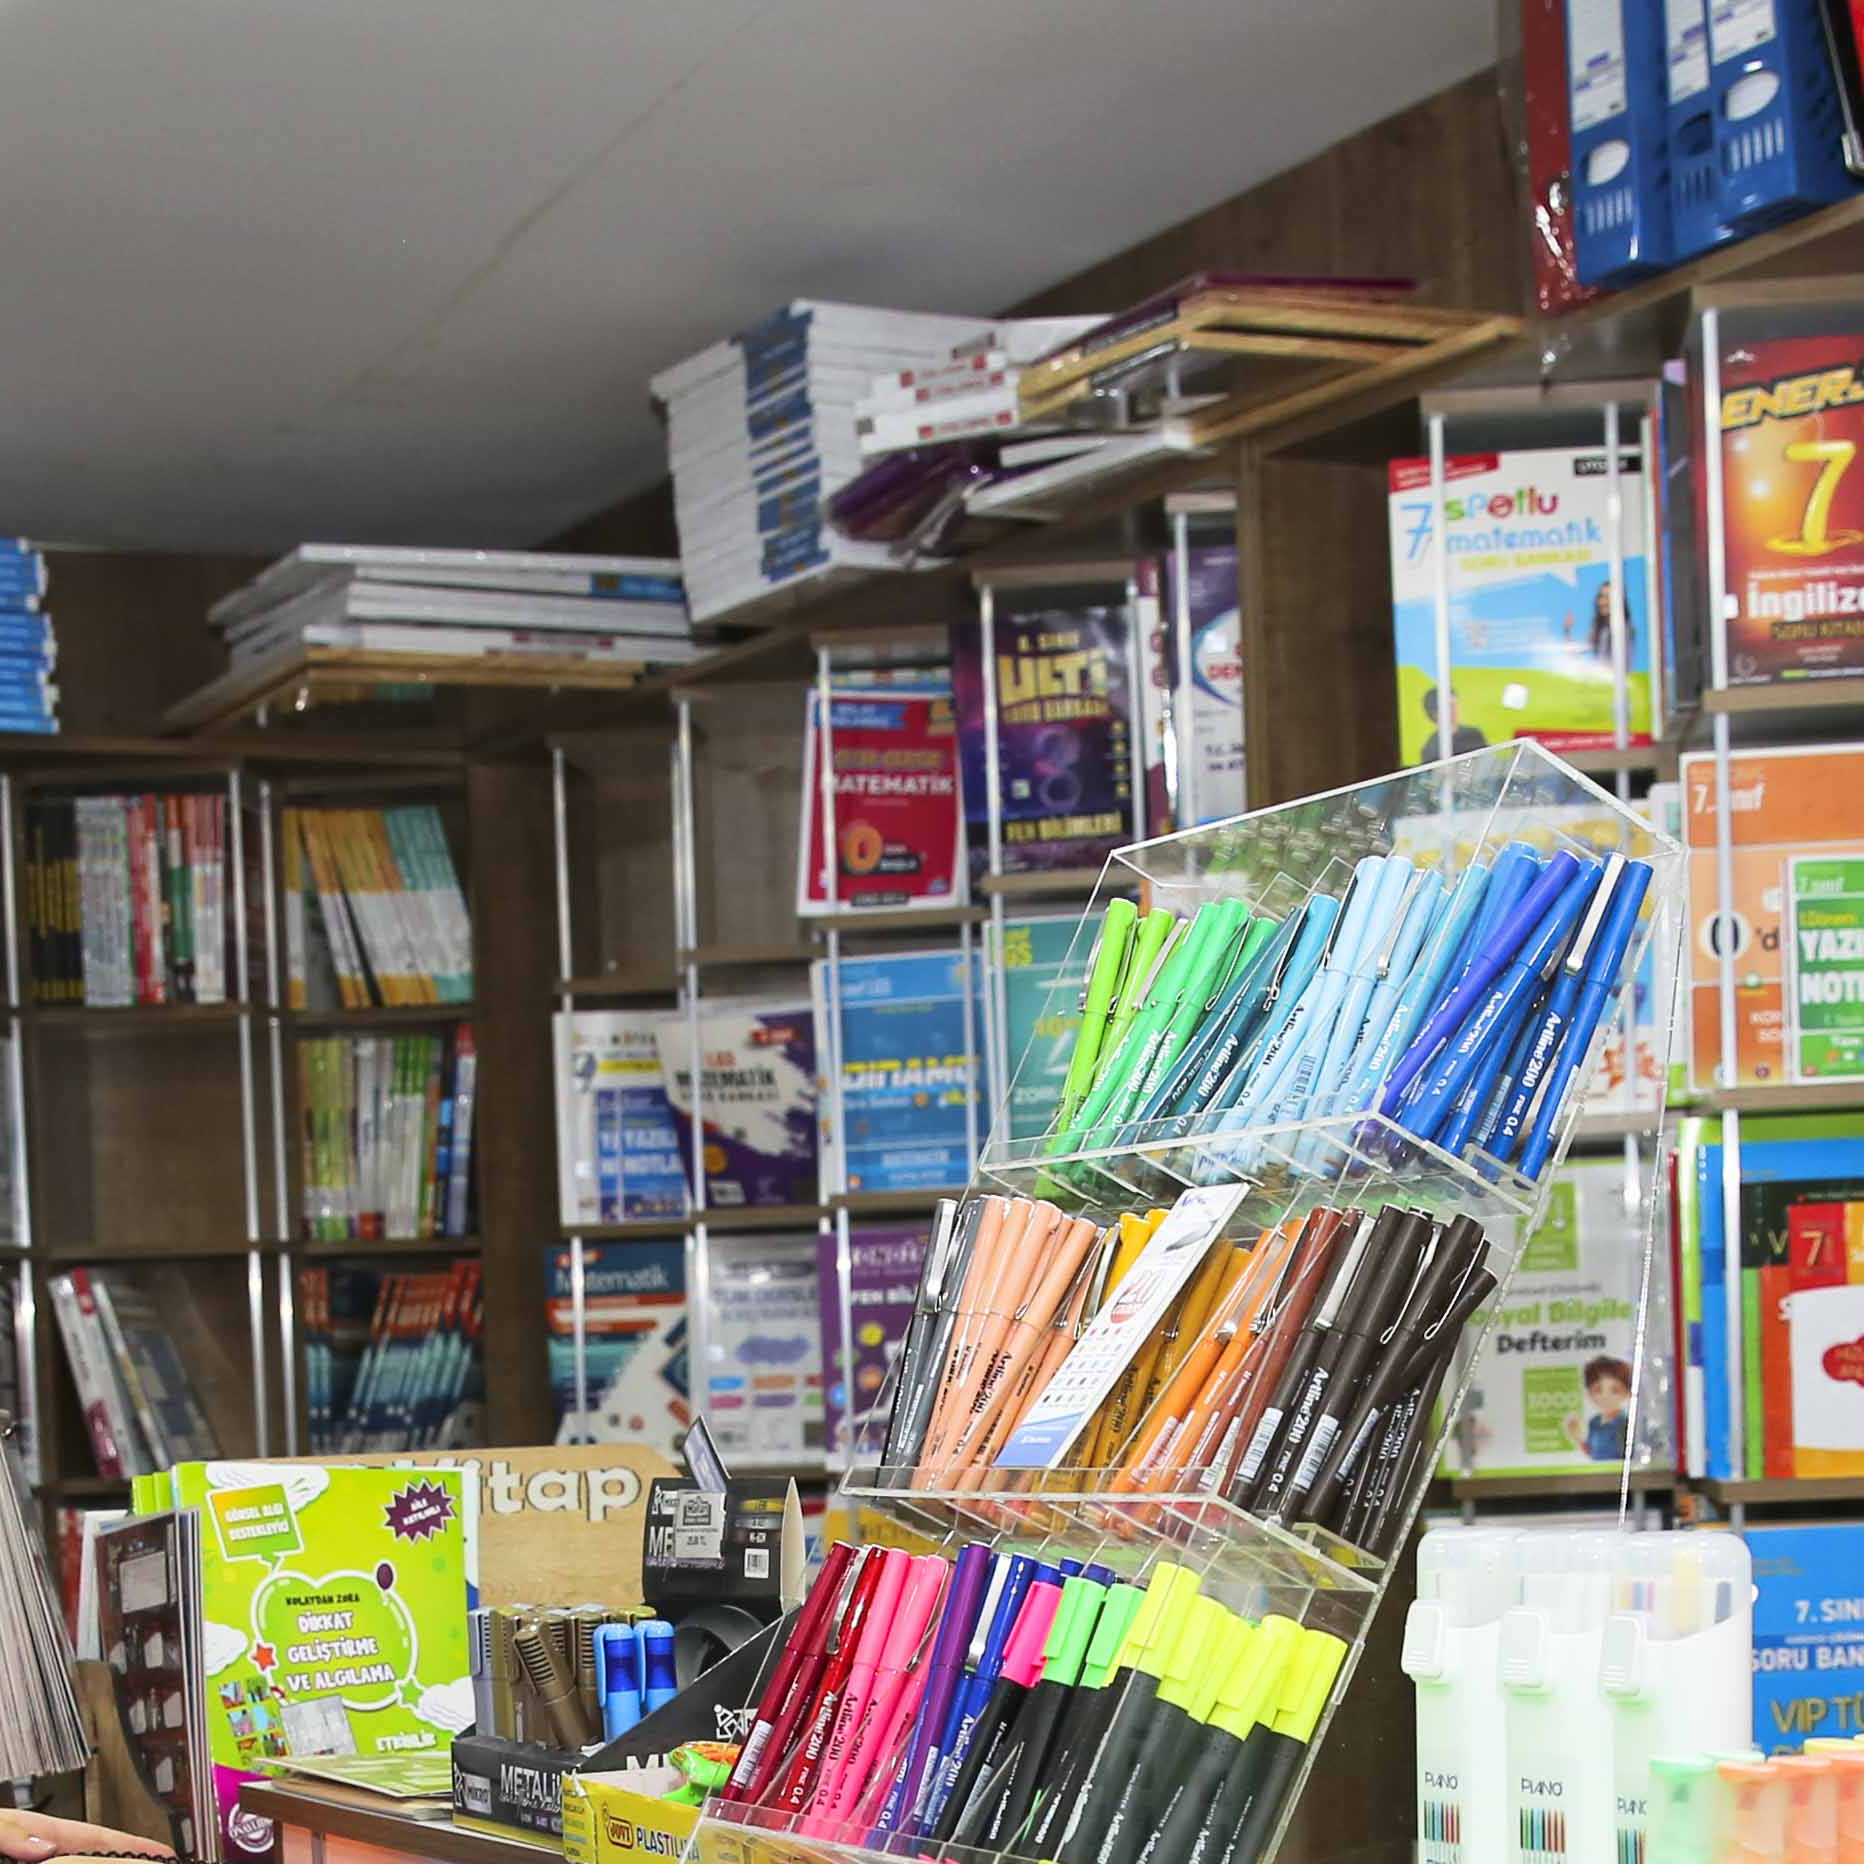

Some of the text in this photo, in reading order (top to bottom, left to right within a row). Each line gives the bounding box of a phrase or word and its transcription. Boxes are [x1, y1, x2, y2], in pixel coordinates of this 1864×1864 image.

[1784, 440, 1857, 551] 7
[1445, 516, 1602, 557] matematik
[1496, 1331, 1607, 1354] Defterim
[296, 1611, 354, 1633] DİKKAT
[1794, 1599, 1819, 1624] 7.
[287, 1636, 379, 1664] GELİŞTİRME
[286, 1665, 395, 1692] VE ALGILAMA
[1770, 1696, 1827, 1734] VIP
[1424, 1771, 1459, 1791] PIANO
[1520, 1777, 1564, 1797] PIANO
